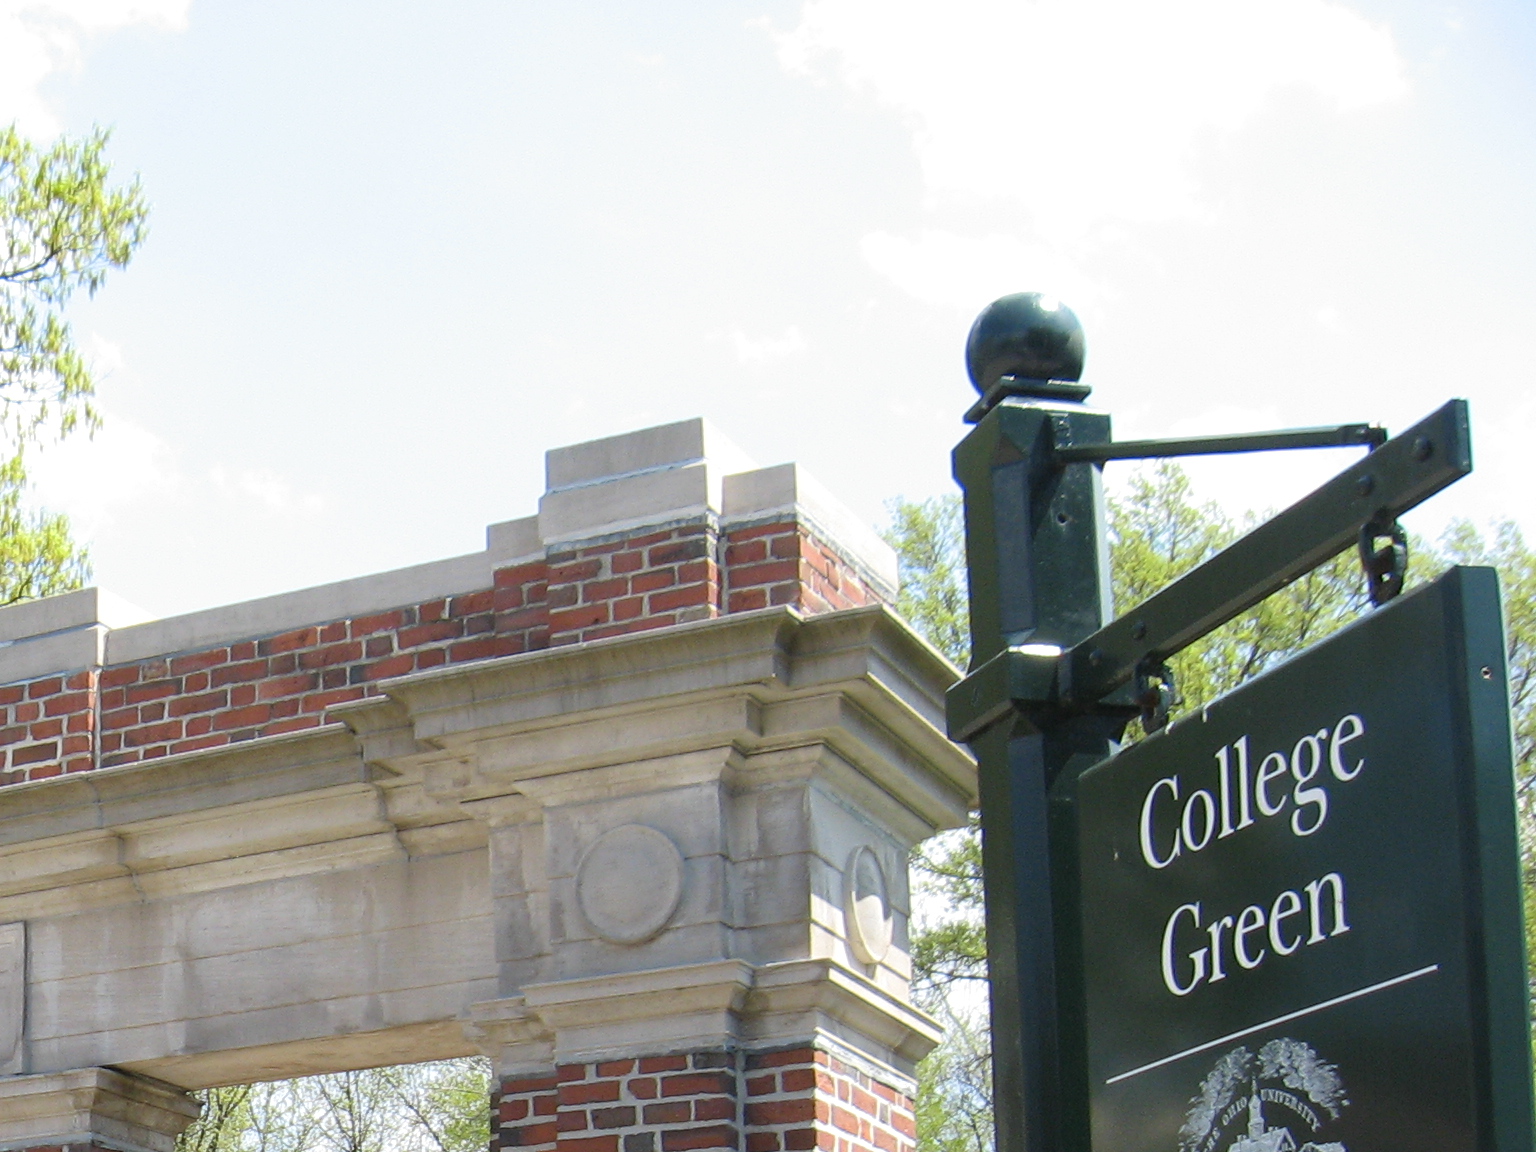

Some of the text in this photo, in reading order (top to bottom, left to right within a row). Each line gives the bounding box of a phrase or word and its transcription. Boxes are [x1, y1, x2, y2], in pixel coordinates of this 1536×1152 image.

[1139, 713, 1365, 869] College
[1161, 872, 1351, 997] Green
[1221, 1096, 1248, 1126] OHIO
[1260, 1088, 1322, 1134] UNIVERSITY
